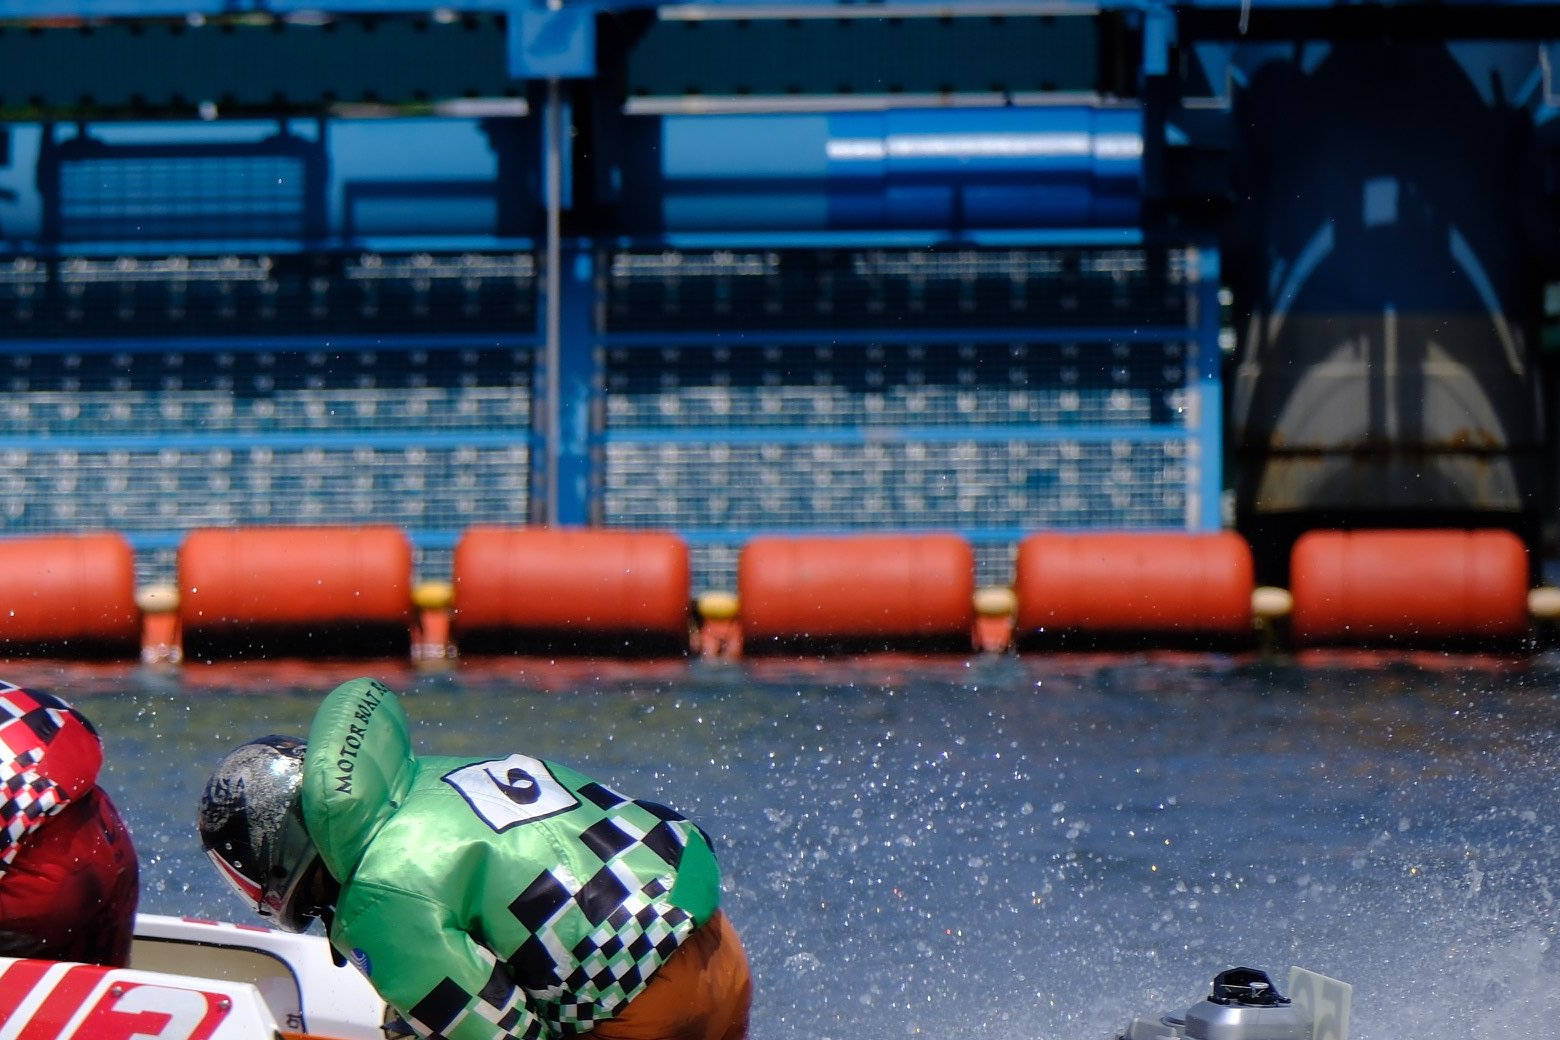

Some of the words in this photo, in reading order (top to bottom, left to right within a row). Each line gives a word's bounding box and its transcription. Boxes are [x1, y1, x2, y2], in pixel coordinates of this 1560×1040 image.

[335, 724, 366, 795] MOTOR
[355, 690, 381, 725] BOAT
[482, 767, 542, 805] 6
